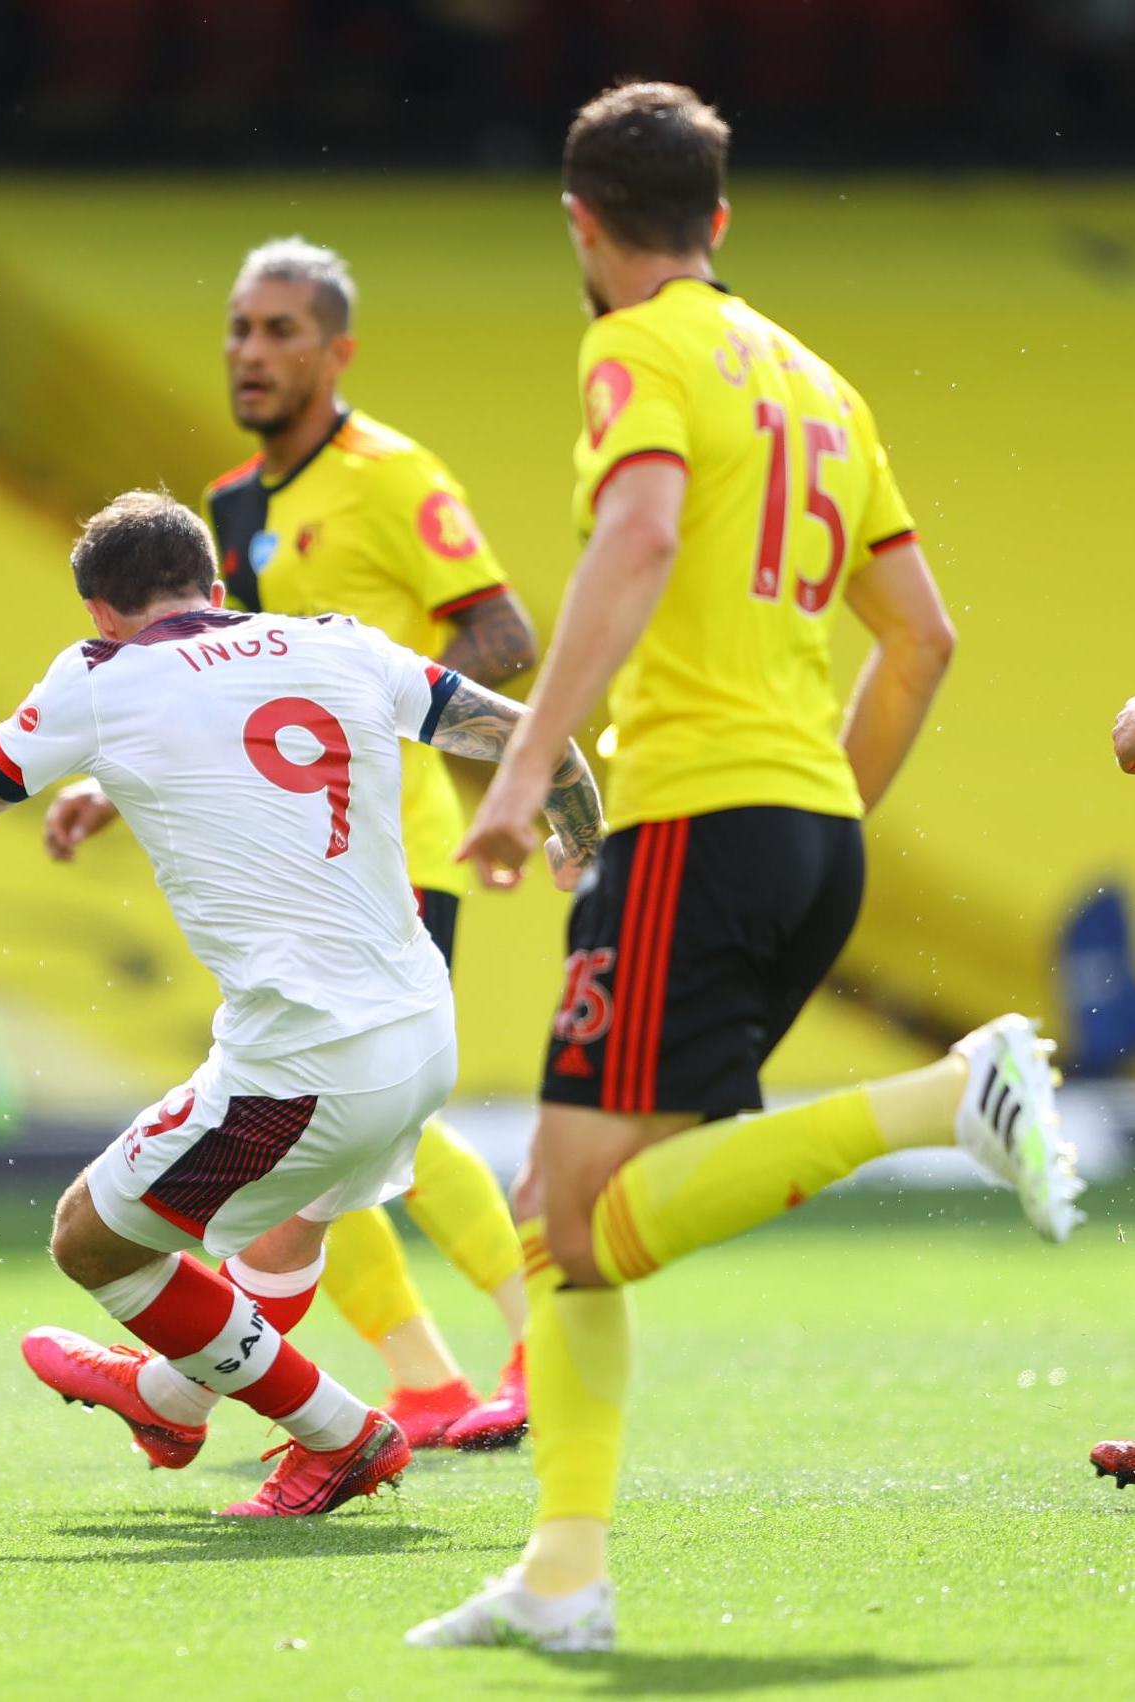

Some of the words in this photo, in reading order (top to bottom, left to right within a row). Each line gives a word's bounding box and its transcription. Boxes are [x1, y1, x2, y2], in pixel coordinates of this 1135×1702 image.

[749, 398, 848, 614] 15
[176, 629, 289, 673] INGS
[242, 695, 353, 861] 9
[554, 948, 615, 1045] 15
[140, 1087, 196, 1138] 9
